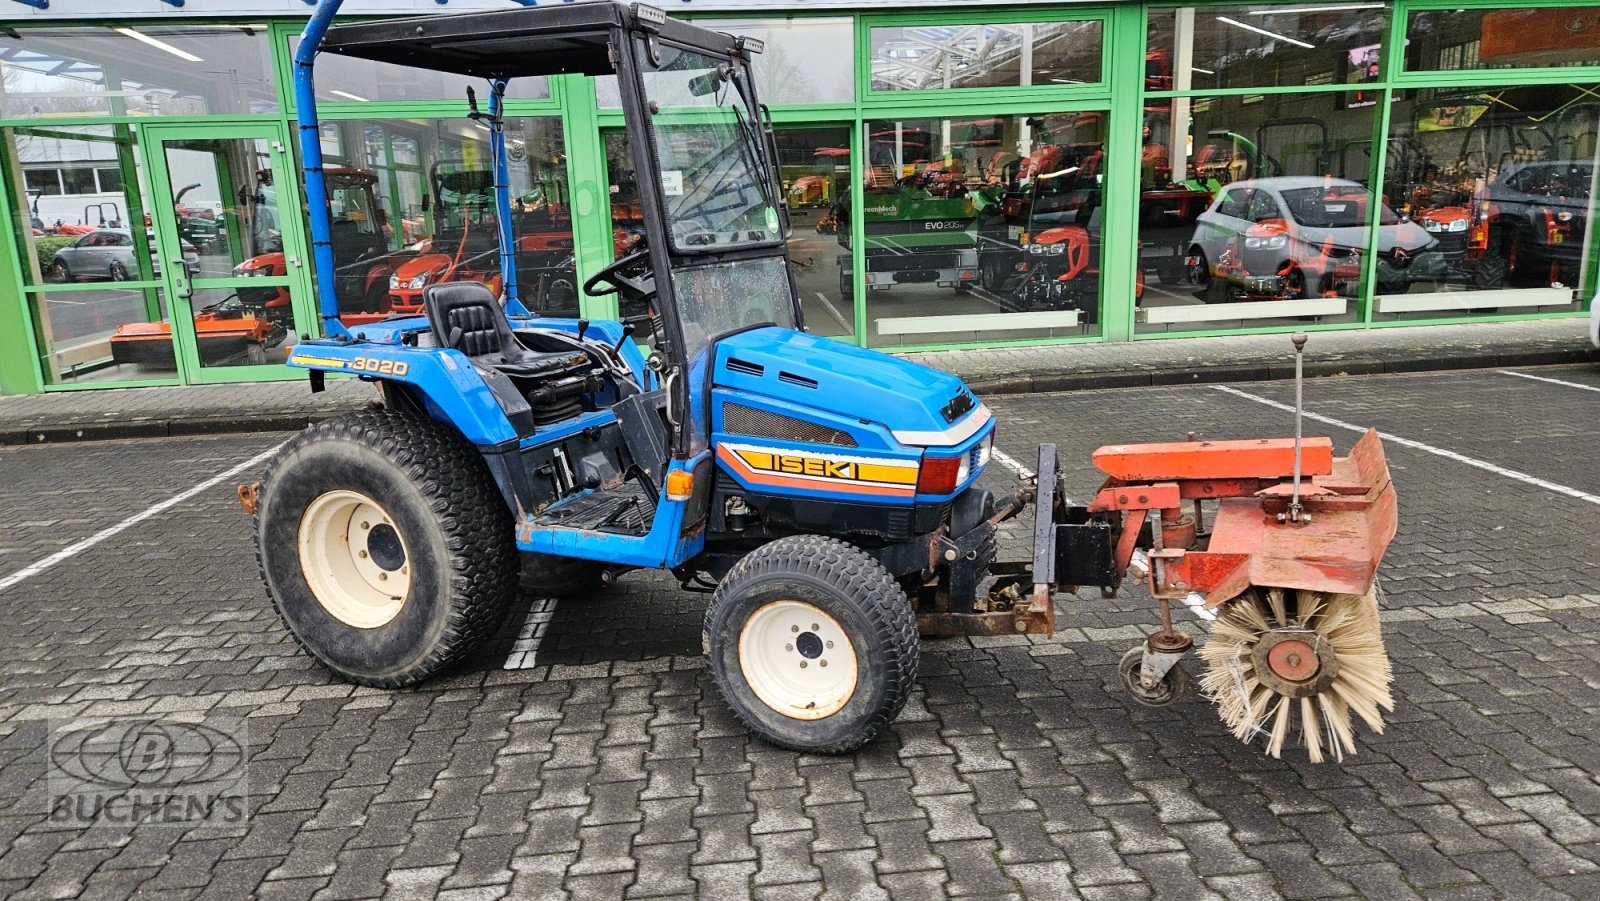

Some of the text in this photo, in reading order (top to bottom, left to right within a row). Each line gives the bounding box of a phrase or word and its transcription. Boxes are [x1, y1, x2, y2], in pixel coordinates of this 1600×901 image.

[864, 204, 897, 213] reenMech
[352, 356, 410, 376] 3020
[773, 454, 858, 480] ISEKI
